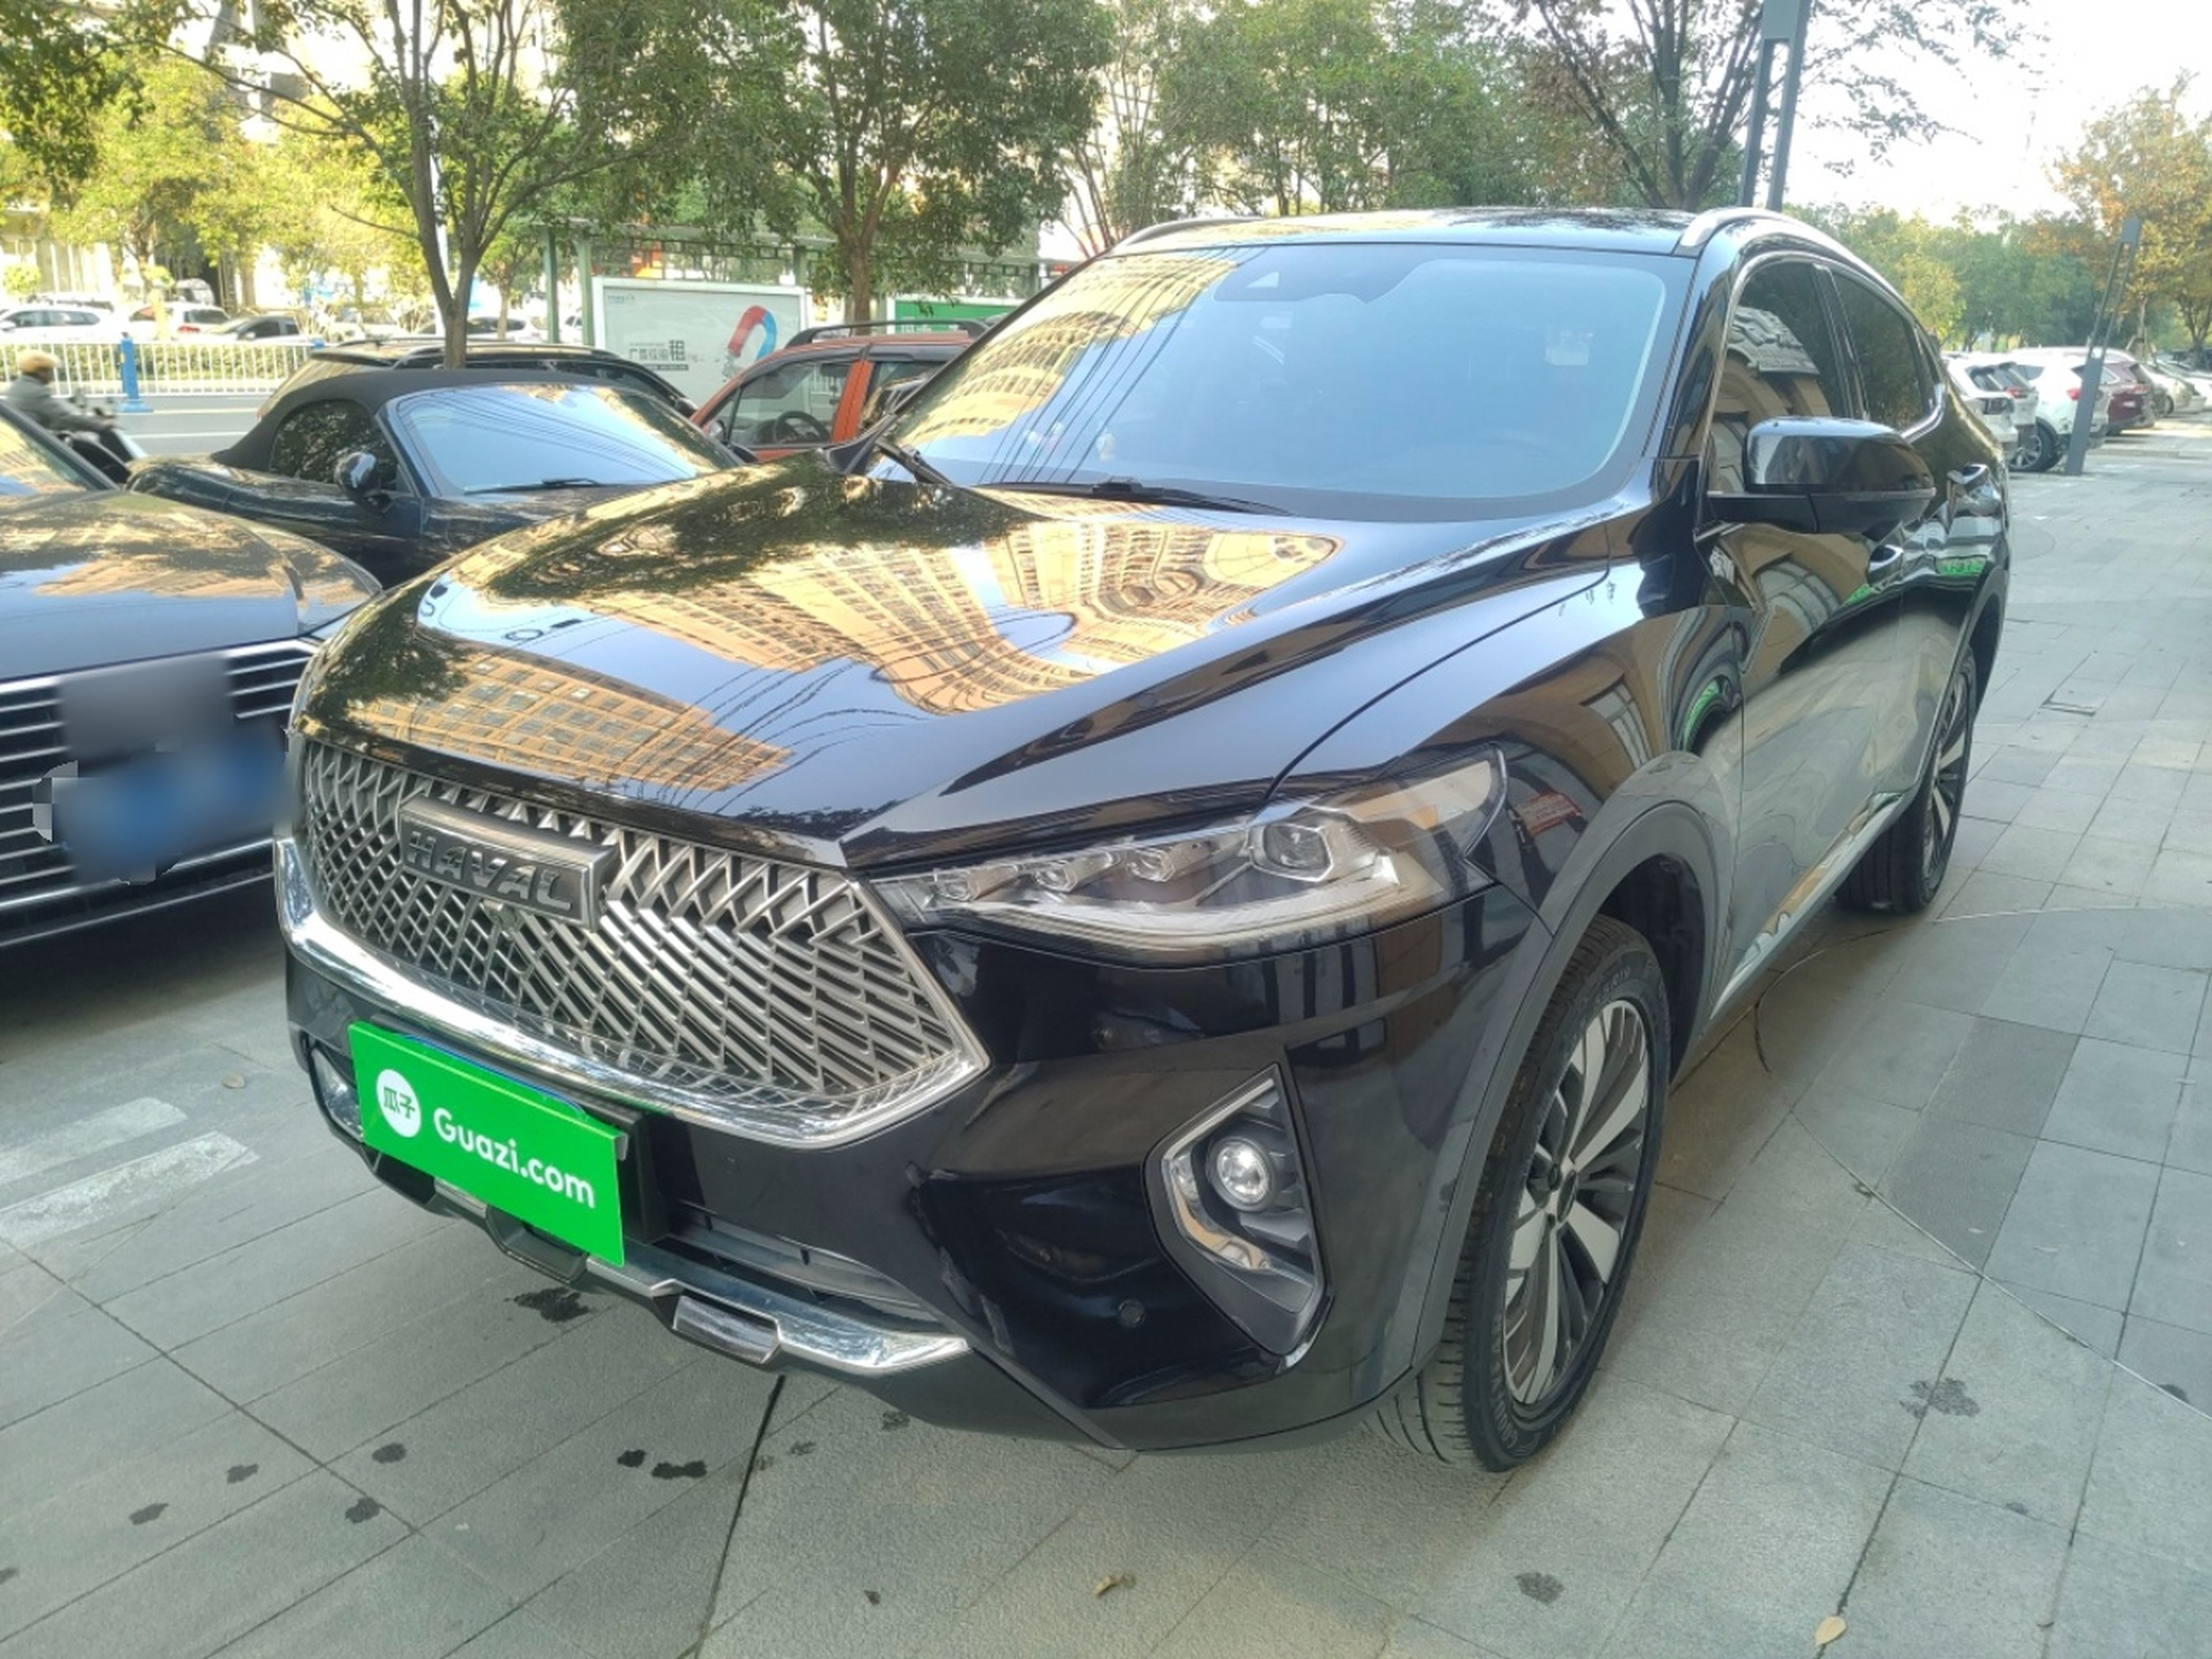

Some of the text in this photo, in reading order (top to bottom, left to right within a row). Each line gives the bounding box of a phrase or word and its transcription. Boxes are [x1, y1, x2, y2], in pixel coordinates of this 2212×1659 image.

[407, 831, 571, 911] HAVAL
[383, 1086, 415, 1120] 瓜子
[433, 1108, 594, 1209] Guazi.com
